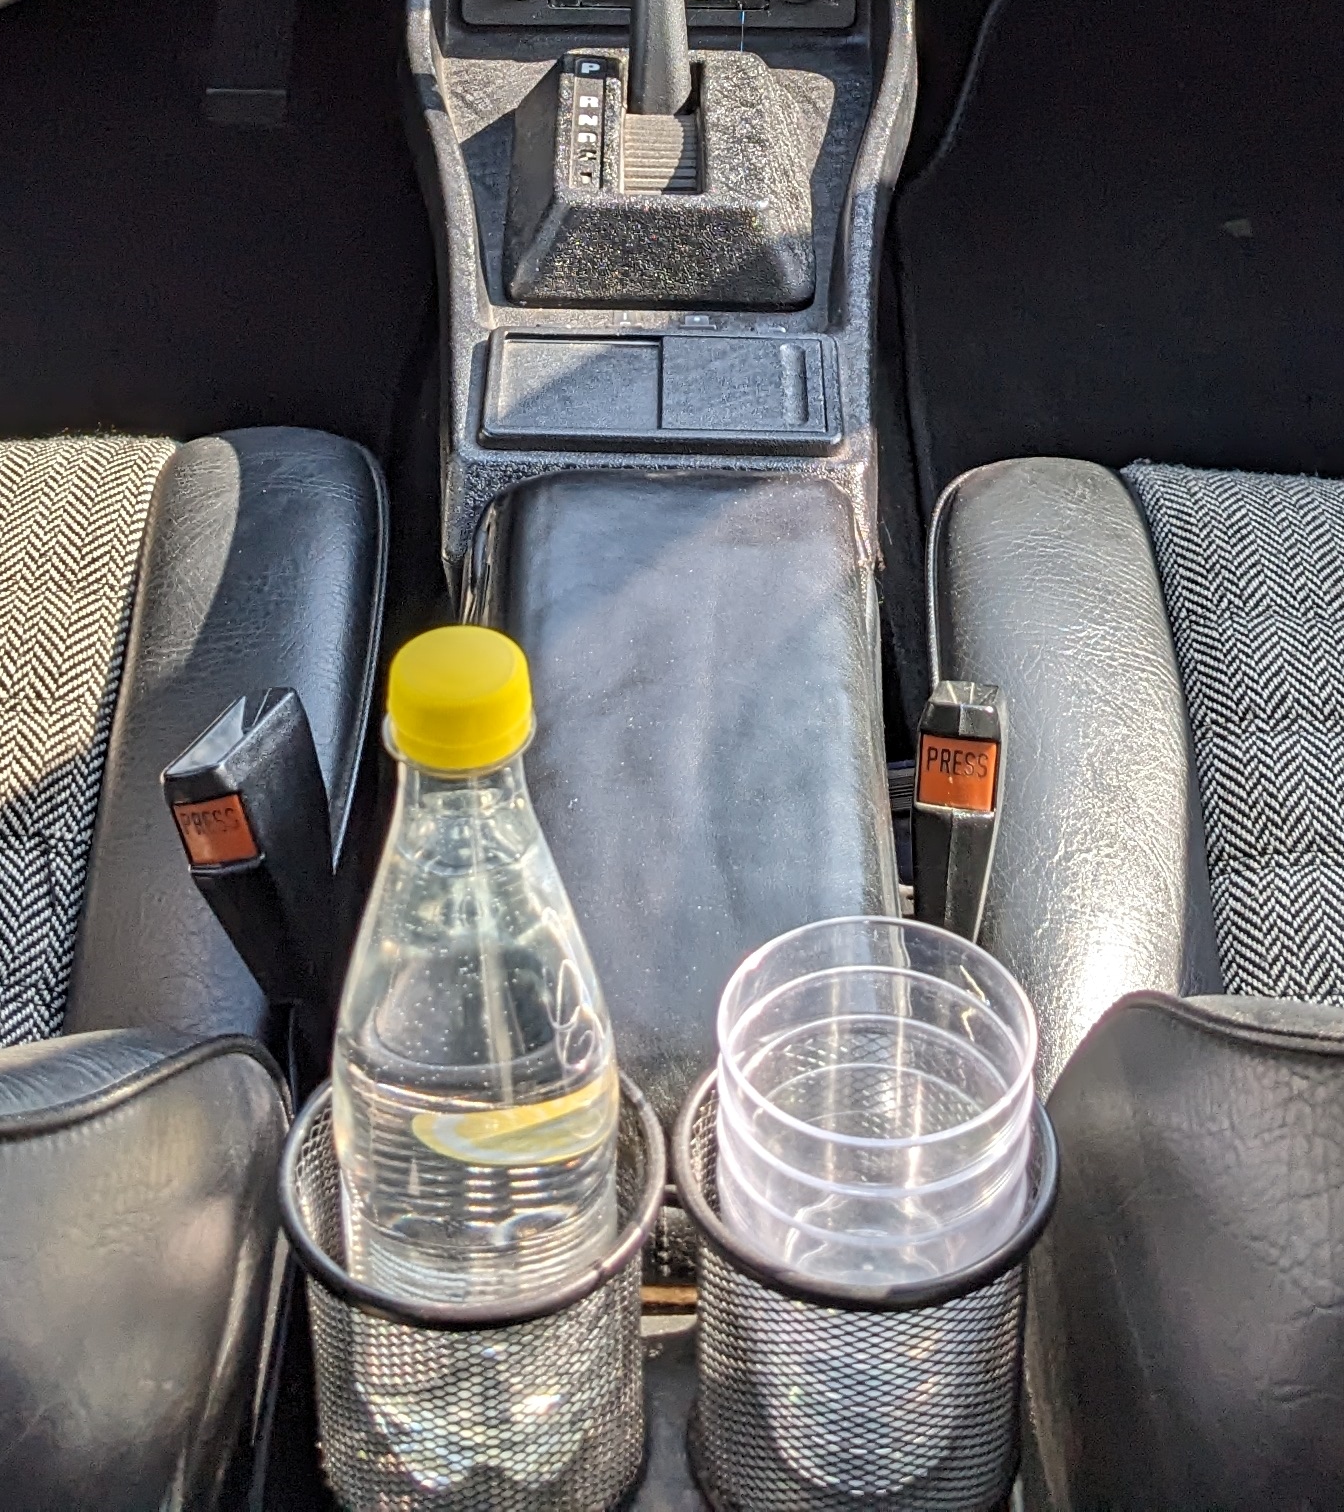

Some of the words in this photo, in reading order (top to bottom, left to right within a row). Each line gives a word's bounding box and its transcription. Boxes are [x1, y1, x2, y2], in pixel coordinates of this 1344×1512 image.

[581, 62, 601, 74] P
[579, 95, 599, 108] R
[578, 114, 598, 126] N
[926, 746, 989, 778] PRESS
[179, 807, 239, 836] PRESS
